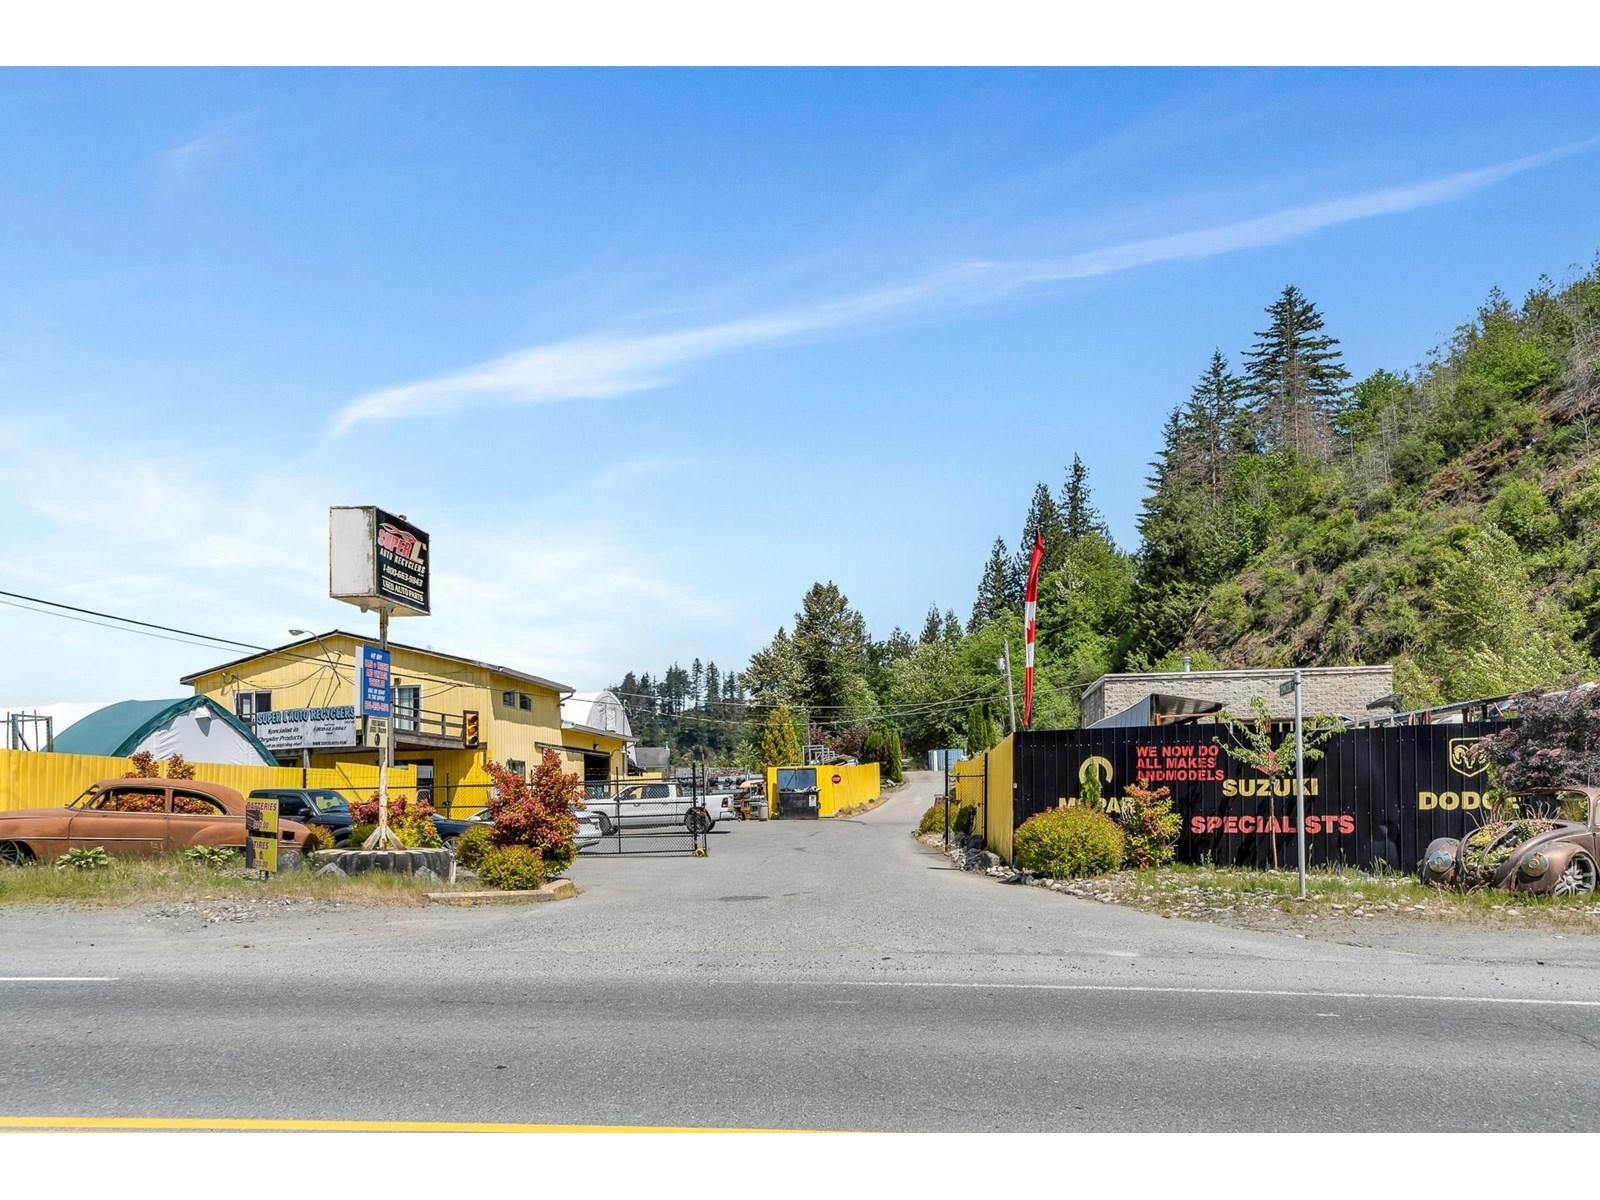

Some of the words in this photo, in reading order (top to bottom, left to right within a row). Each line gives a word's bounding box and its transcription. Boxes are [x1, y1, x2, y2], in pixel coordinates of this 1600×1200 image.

[380, 548, 393, 561] AUTO
[394, 553, 426, 574] RECYCLERS
[257, 711, 281, 726] SUPER
[310, 706, 356, 722] RECYCLERS
[1136, 746, 1157, 757] WE
[1162, 745, 1195, 757] NOW
[1199, 745, 1219, 756] DO
[1136, 757, 1161, 769] ALL
[1166, 757, 1217, 769] MAKES
[1222, 778, 1319, 797] SUZUKI
[247, 801, 277, 811] BATTERIES
[1058, 797, 1136, 814] MPAR
[1191, 815, 1355, 834] SPECIALSTS
[254, 840, 269, 849] TIRES
